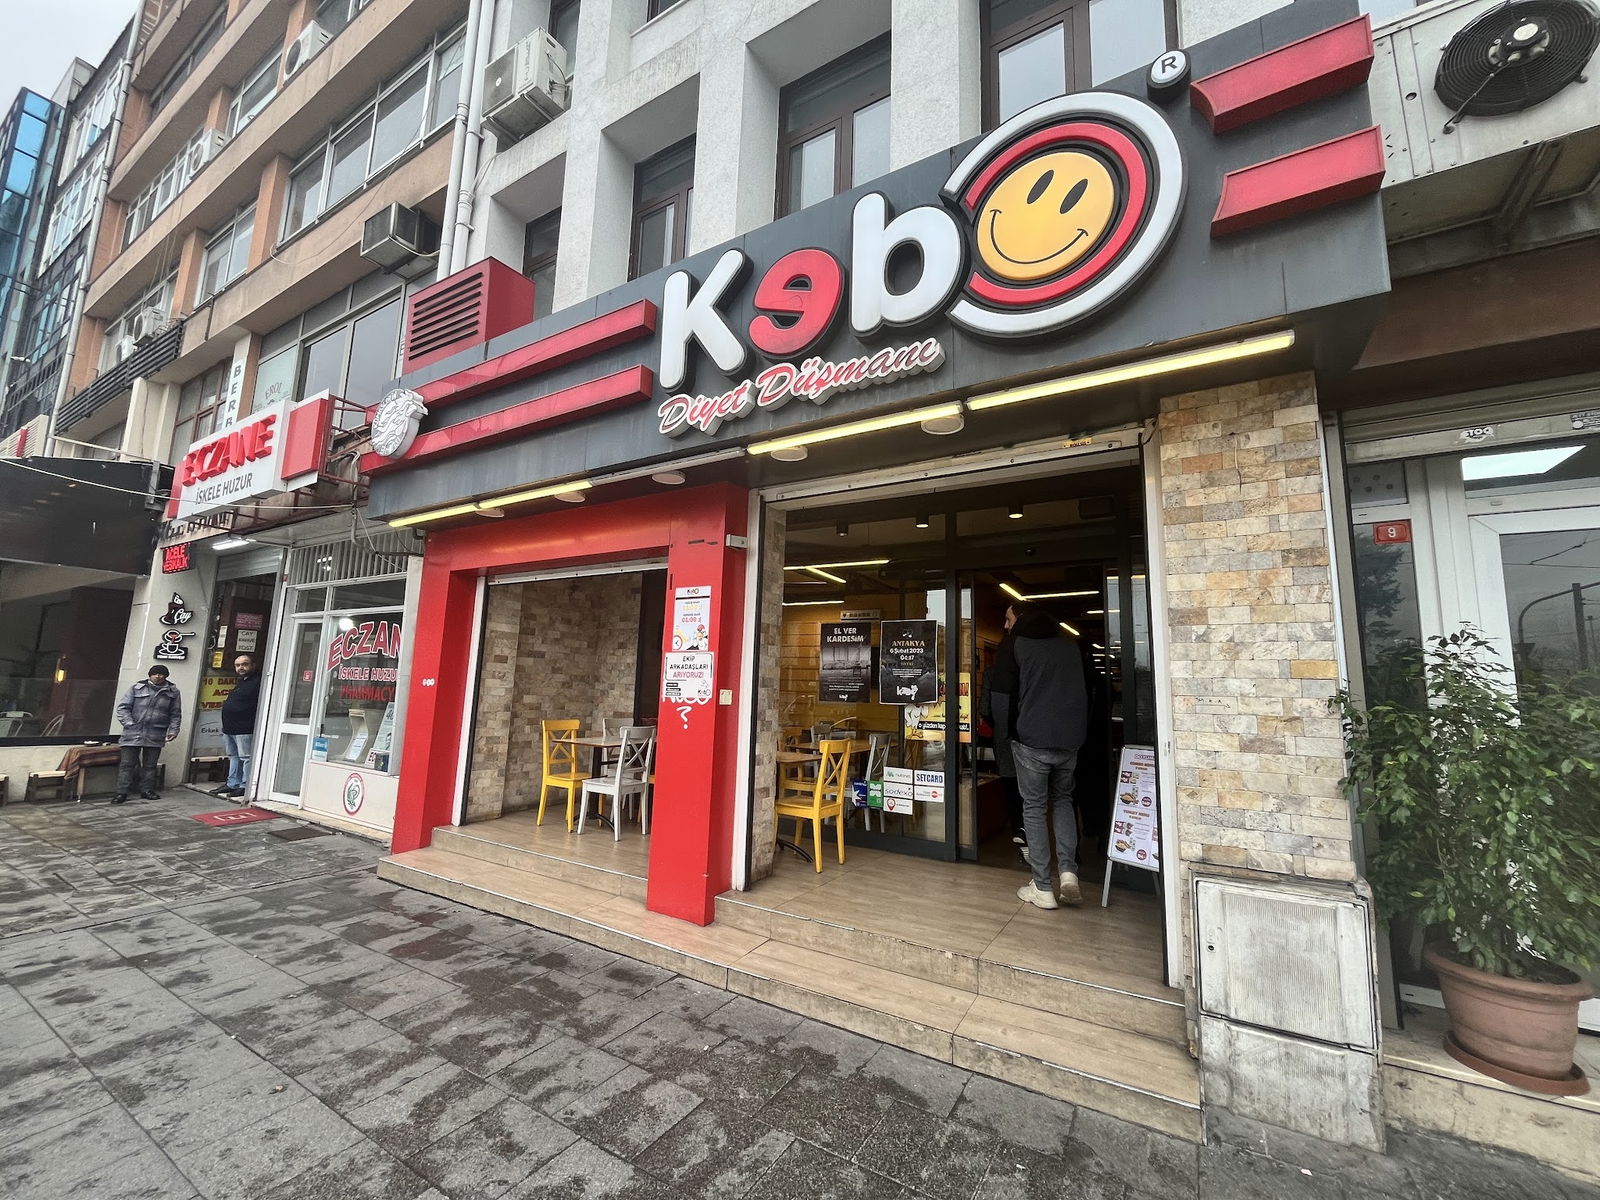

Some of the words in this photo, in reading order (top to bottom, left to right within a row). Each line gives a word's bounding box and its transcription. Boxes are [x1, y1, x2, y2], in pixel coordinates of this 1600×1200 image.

[657, 380, 752, 434] Diyet
[182, 414, 277, 487] ECZANE
[222, 472, 253, 496] HUZUR
[1388, 527, 1397, 538] 9
[174, 608, 192, 624] Çay
[326, 620, 402, 671] ECZAN
[338, 665, 370, 681] İSKELE
[370, 668, 400, 681] HUZU
[916, 773, 943, 784] SETCARD
